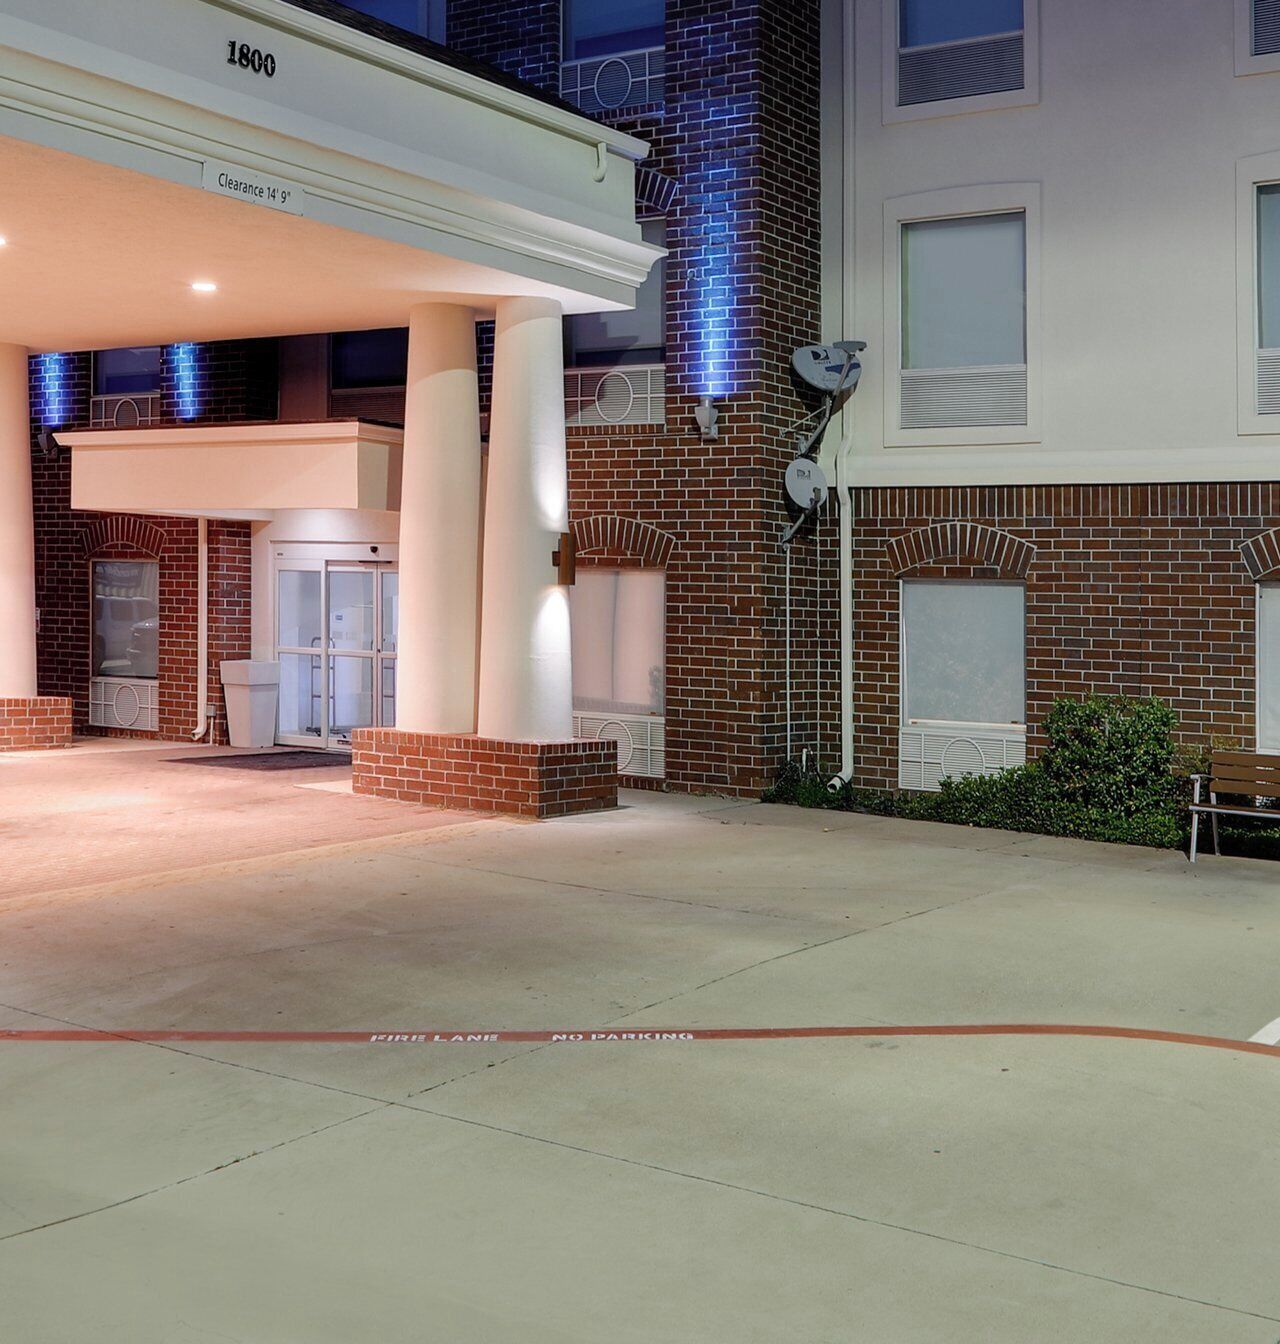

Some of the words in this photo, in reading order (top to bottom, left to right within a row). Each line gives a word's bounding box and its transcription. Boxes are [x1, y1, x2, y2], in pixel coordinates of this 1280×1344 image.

[227, 40, 276, 78] 1800
[218, 172, 264, 198] Clearance
[267, 186, 279, 201] 14'
[281, 190, 291, 204] 9"
[370, 1034, 426, 1043] FIRE
[433, 1034, 499, 1042] LANE
[552, 1033, 584, 1041] NO
[591, 1032, 694, 1041] PARKING
